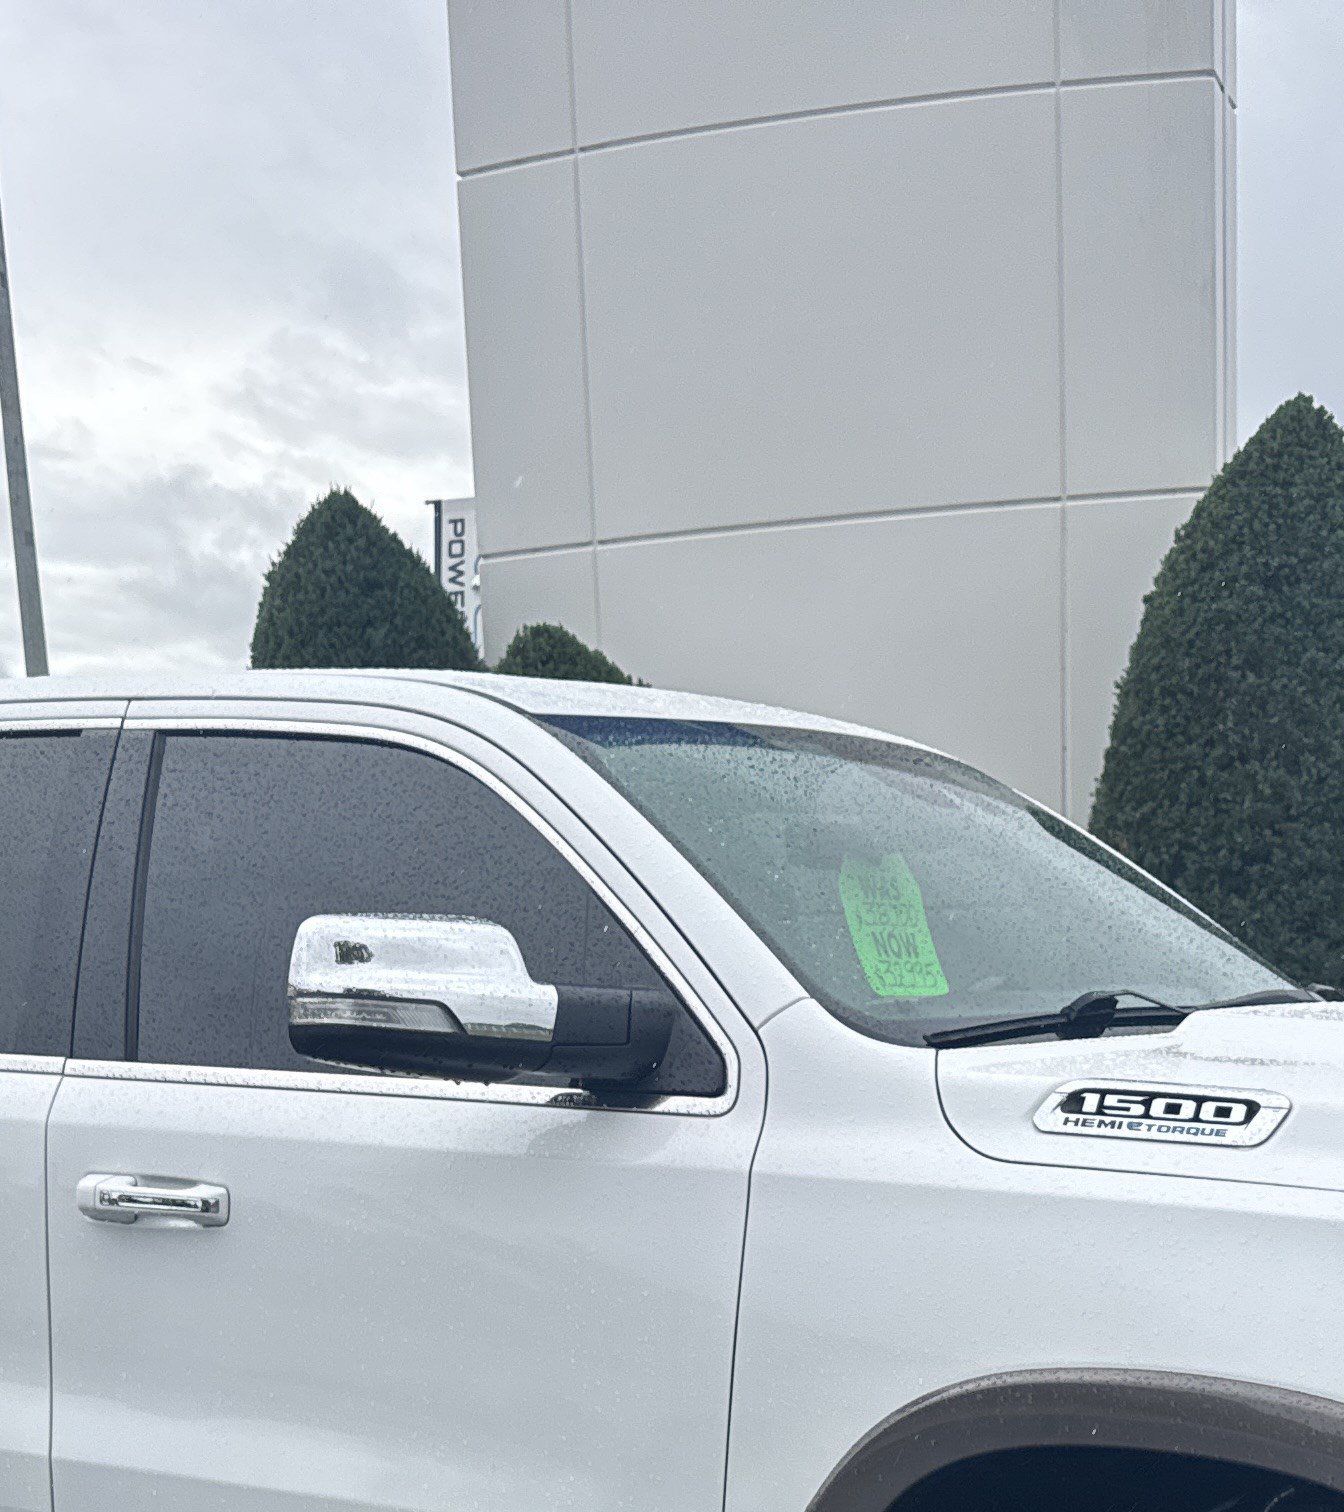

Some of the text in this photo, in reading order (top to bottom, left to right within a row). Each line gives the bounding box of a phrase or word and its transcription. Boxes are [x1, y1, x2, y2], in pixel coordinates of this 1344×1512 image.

[448, 518, 466, 616] POWE
[871, 930, 920, 959] NOW
[1079, 1092, 1248, 1123] 1500
[1063, 1117, 1123, 1131] HEMI
